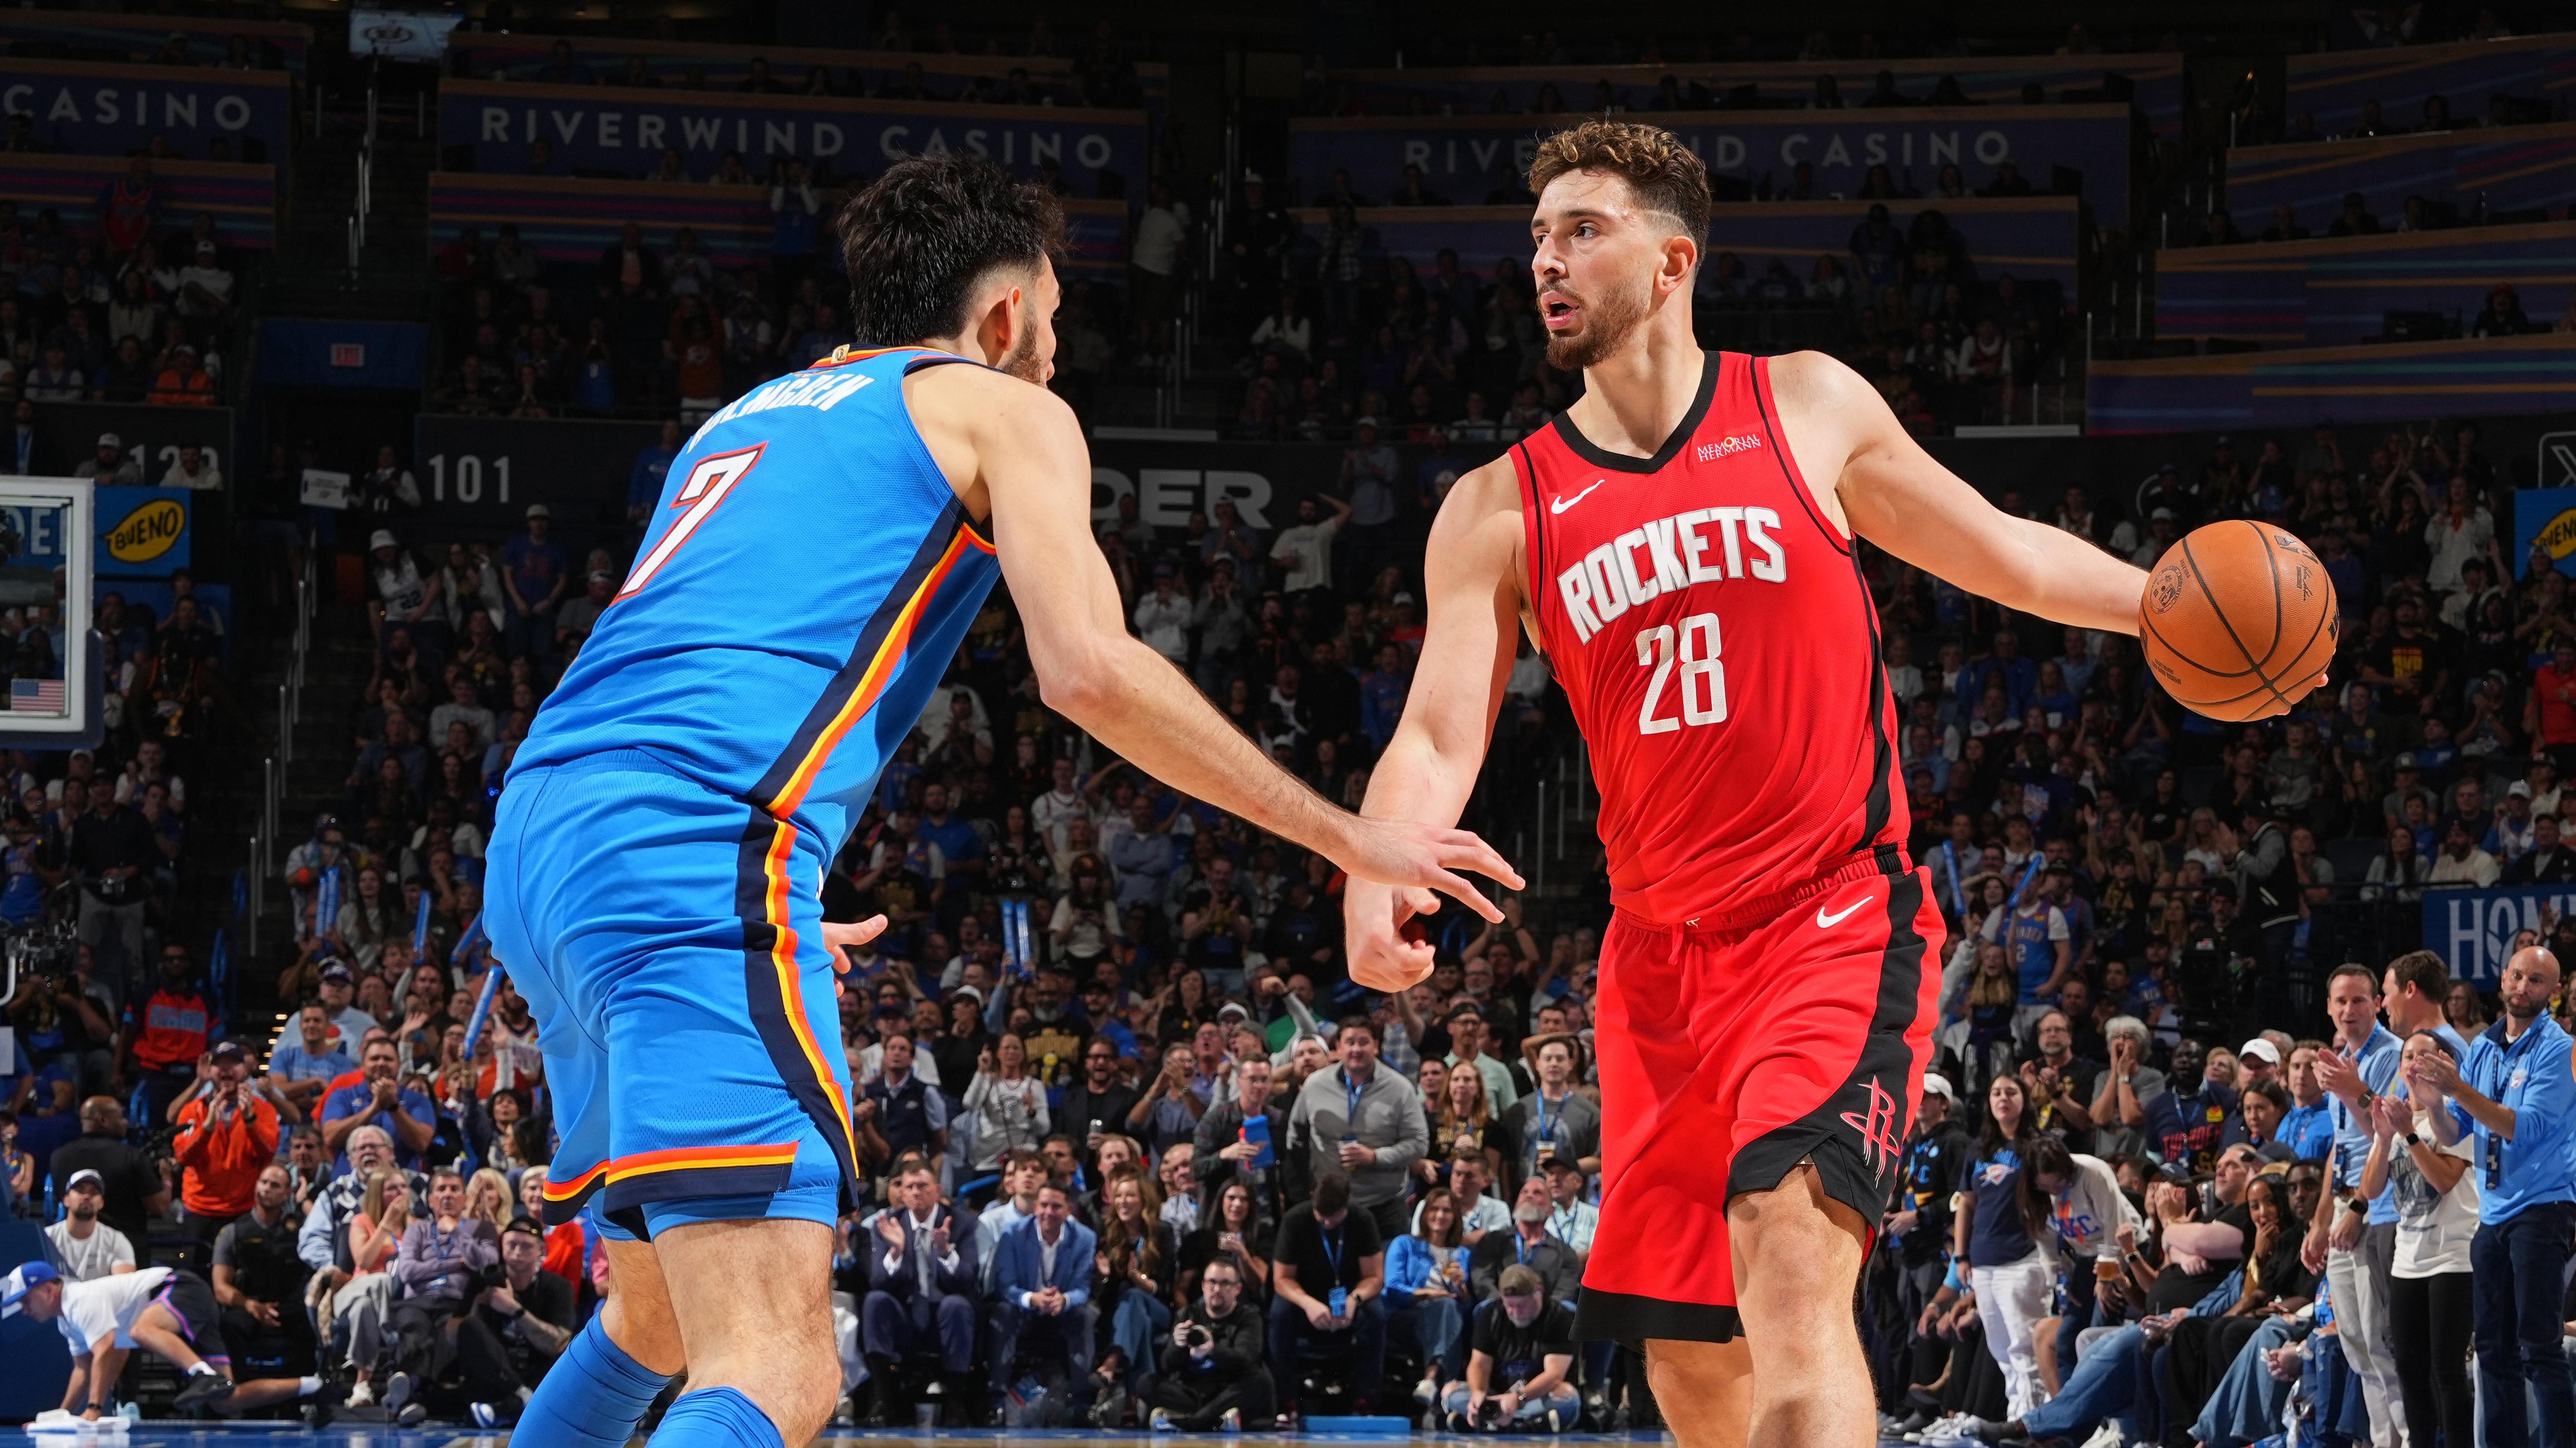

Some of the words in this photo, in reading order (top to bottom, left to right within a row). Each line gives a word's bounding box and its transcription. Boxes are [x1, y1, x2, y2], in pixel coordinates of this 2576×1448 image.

[3, 84, 251, 131] CASINO
[481, 106, 845, 157] RIVERWIND
[879, 125, 1112, 169] CASINO
[1781, 130, 2009, 169] CASINO
[1697, 433, 1760, 454] MEMORIAL
[1698, 440, 1761, 462] HERMANN
[428, 454, 510, 504] 101
[115, 507, 178, 550] BUENO
[609, 441, 769, 607] 7
[1556, 506, 1787, 645] ROCKETS
[1635, 612, 1727, 735] 28
